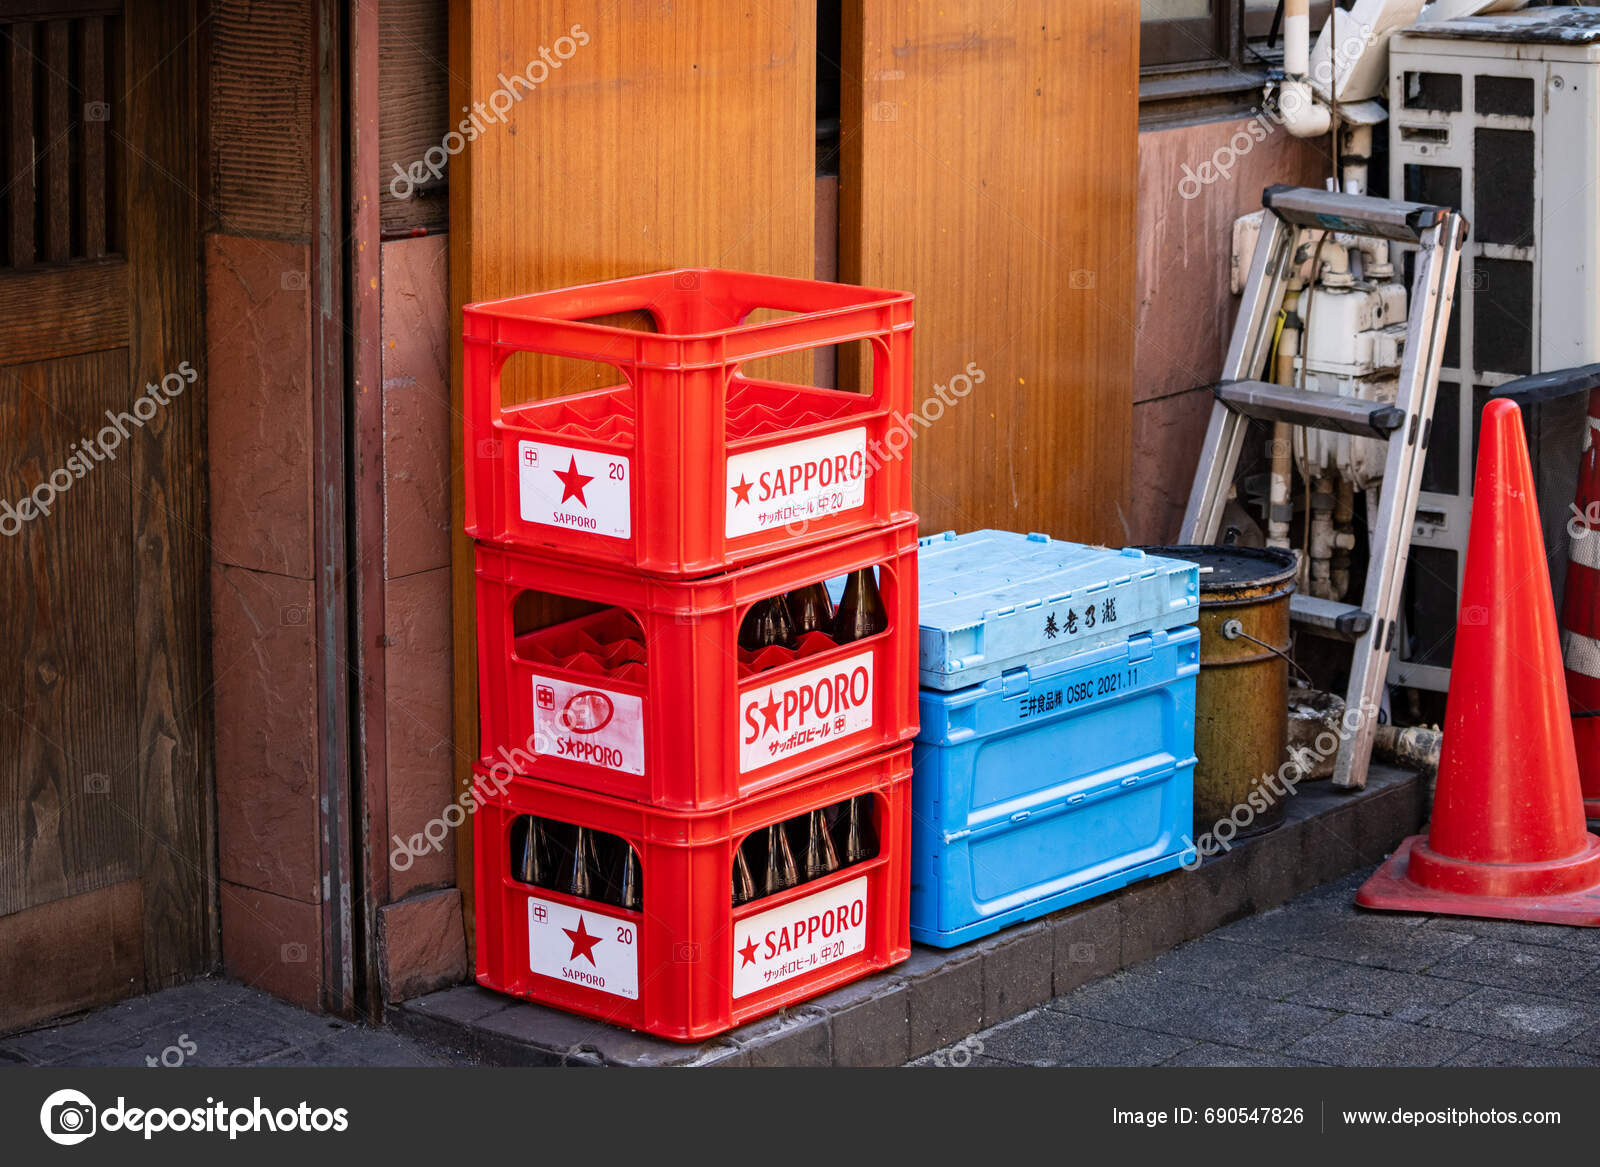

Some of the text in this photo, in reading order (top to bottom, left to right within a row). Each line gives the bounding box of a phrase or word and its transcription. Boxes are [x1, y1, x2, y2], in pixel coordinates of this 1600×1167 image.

[524, 448, 538, 466] 中
[608, 462, 624, 481] 20
[759, 450, 863, 502] SAPPORO
[553, 511, 597, 529] SAPPORO
[1066, 680, 1094, 704] OSBC
[1097, 668, 1138, 696] 2021.11
[537, 687, 554, 708] 中
[768, 722, 831, 756] サッポロビール
[534, 905, 547, 922] 中
[616, 926, 633, 945] 20
[764, 899, 864, 961] SAPPORO
[562, 966, 606, 988] SAPPORO
[763, 953, 818, 982] サッポロビール
